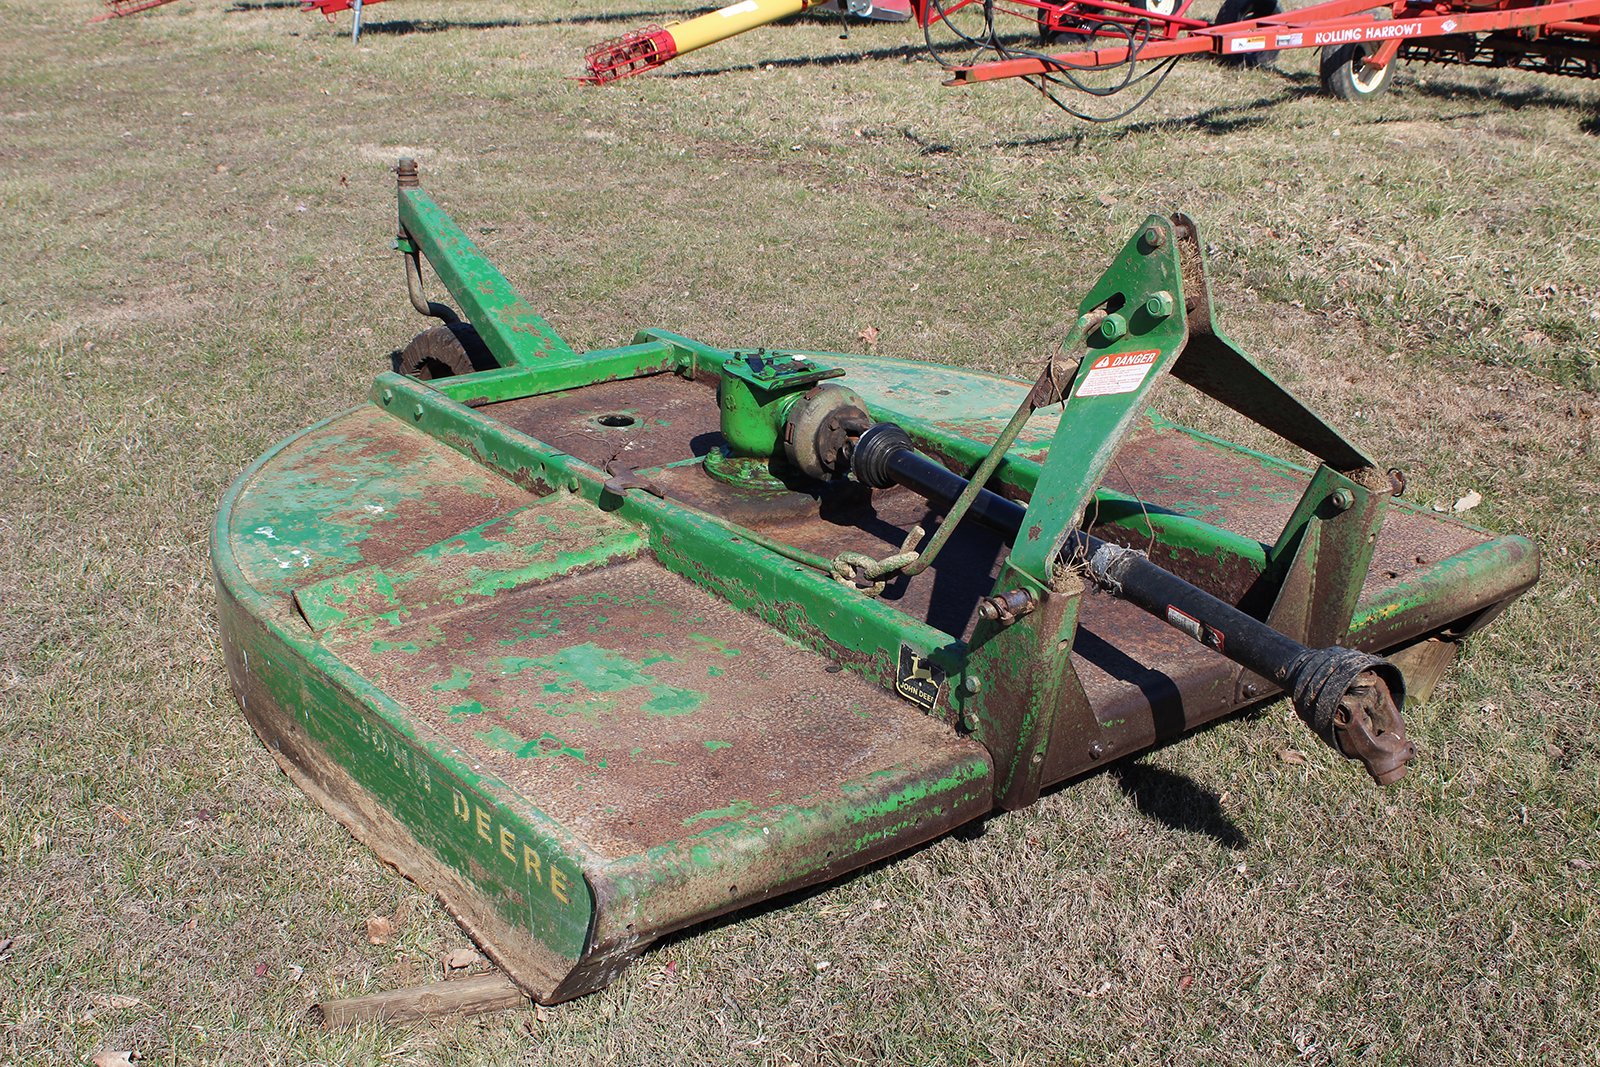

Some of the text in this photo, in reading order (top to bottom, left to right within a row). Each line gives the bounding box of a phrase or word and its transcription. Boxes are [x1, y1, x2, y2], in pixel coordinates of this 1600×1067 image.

[1315, 28, 1361, 44] ROLLING
[1111, 352, 1156, 366] DANGER
[899, 682, 918, 695] JOHN
[452, 786, 569, 905] DEERE
